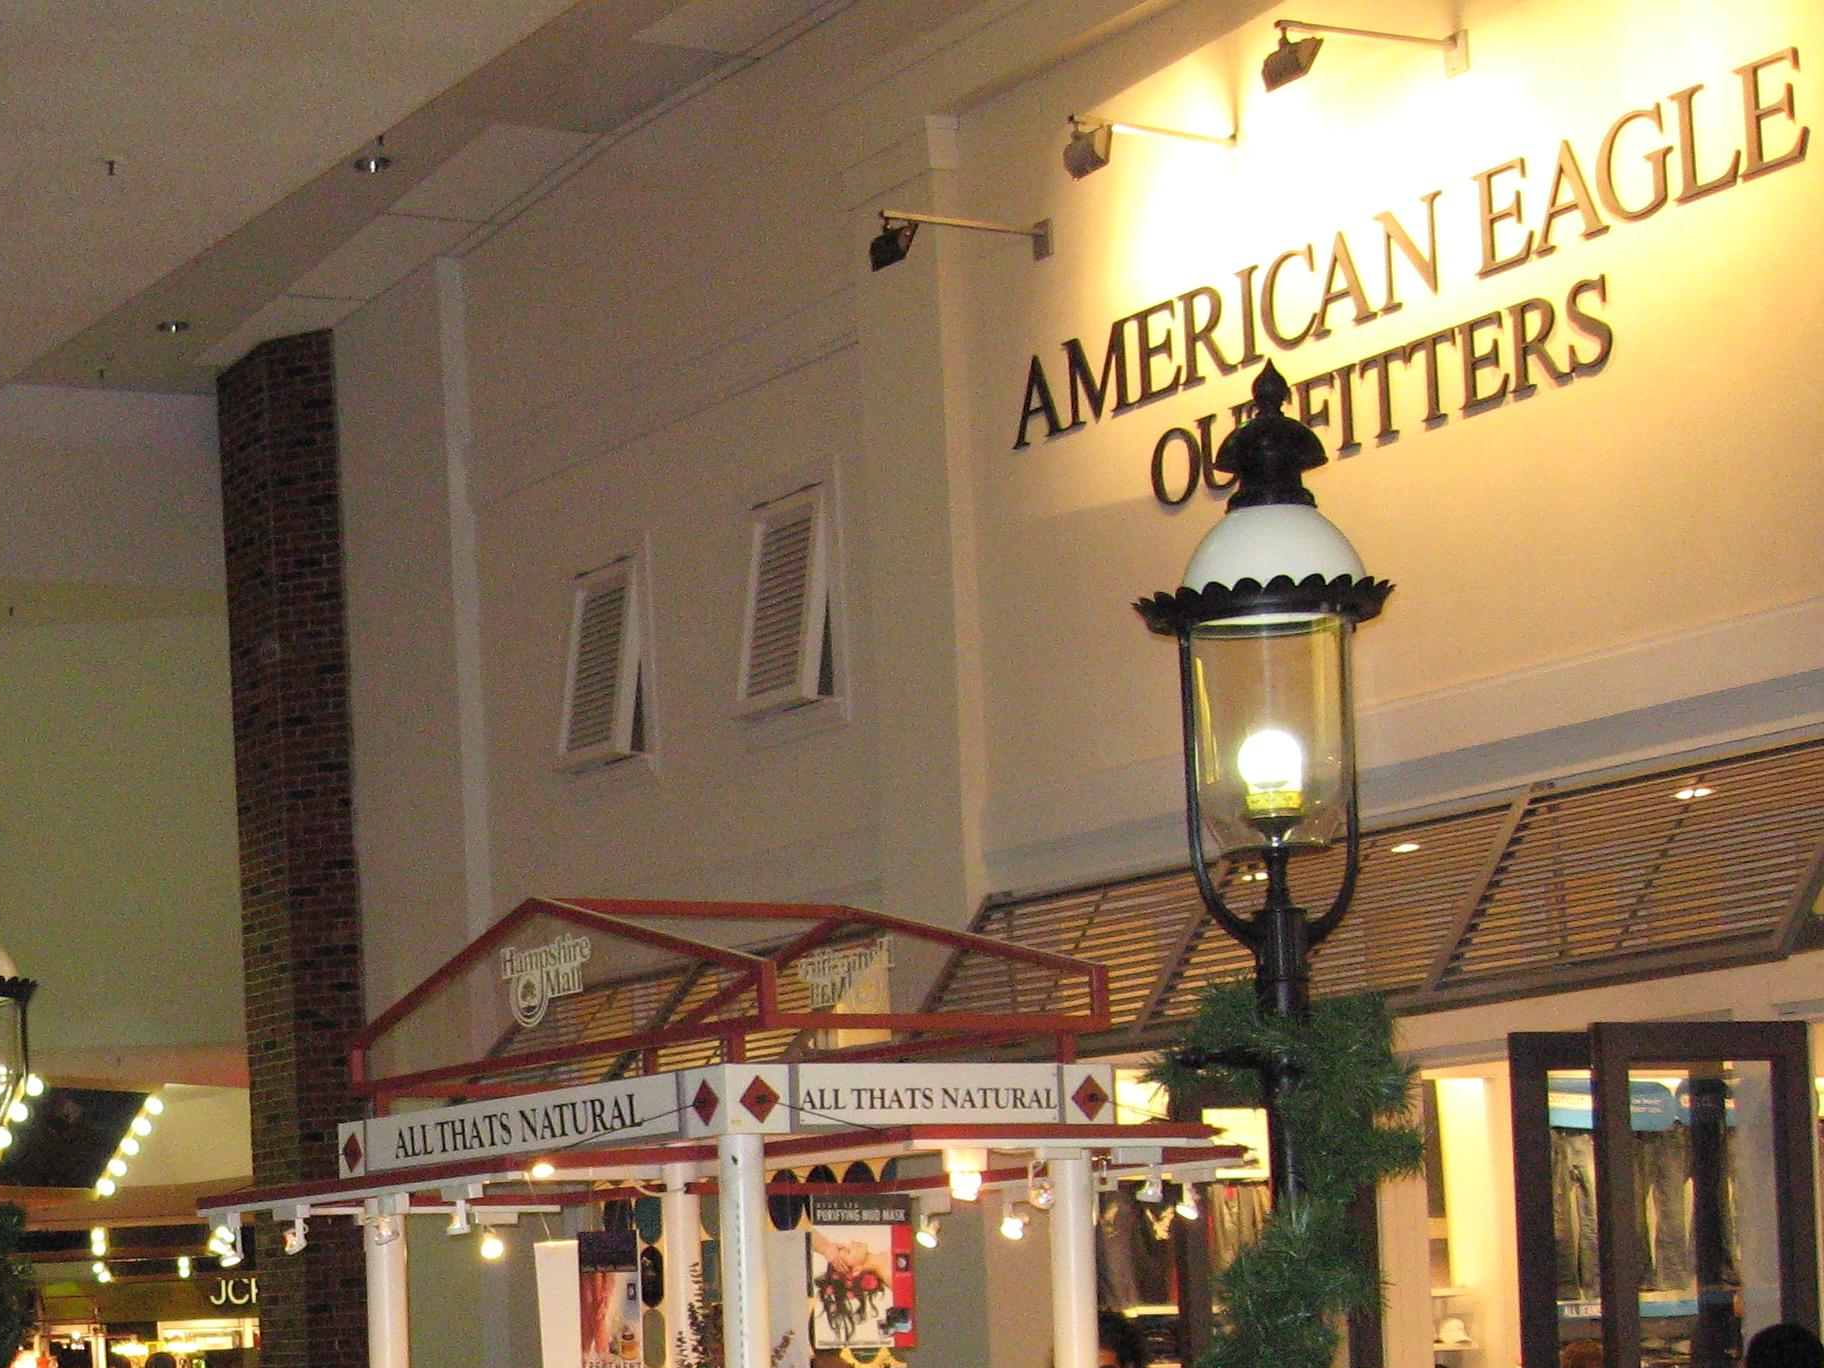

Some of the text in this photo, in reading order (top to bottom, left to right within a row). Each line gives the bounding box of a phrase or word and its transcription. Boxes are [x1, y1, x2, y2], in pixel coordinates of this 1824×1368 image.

[1012, 47, 1810, 449] AMERICAN EAGLE
[1150, 274, 1615, 506] OUFITTERS
[500, 932, 593, 979] Hampshire
[543, 965, 584, 998] Mall
[801, 1087, 1058, 1111] ALL THATS NATURAL
[395, 1093, 644, 1159] ALL THATS NATURAL
[816, 1209, 861, 1222] PURIFYING
[883, 1208, 907, 1221] MASK
